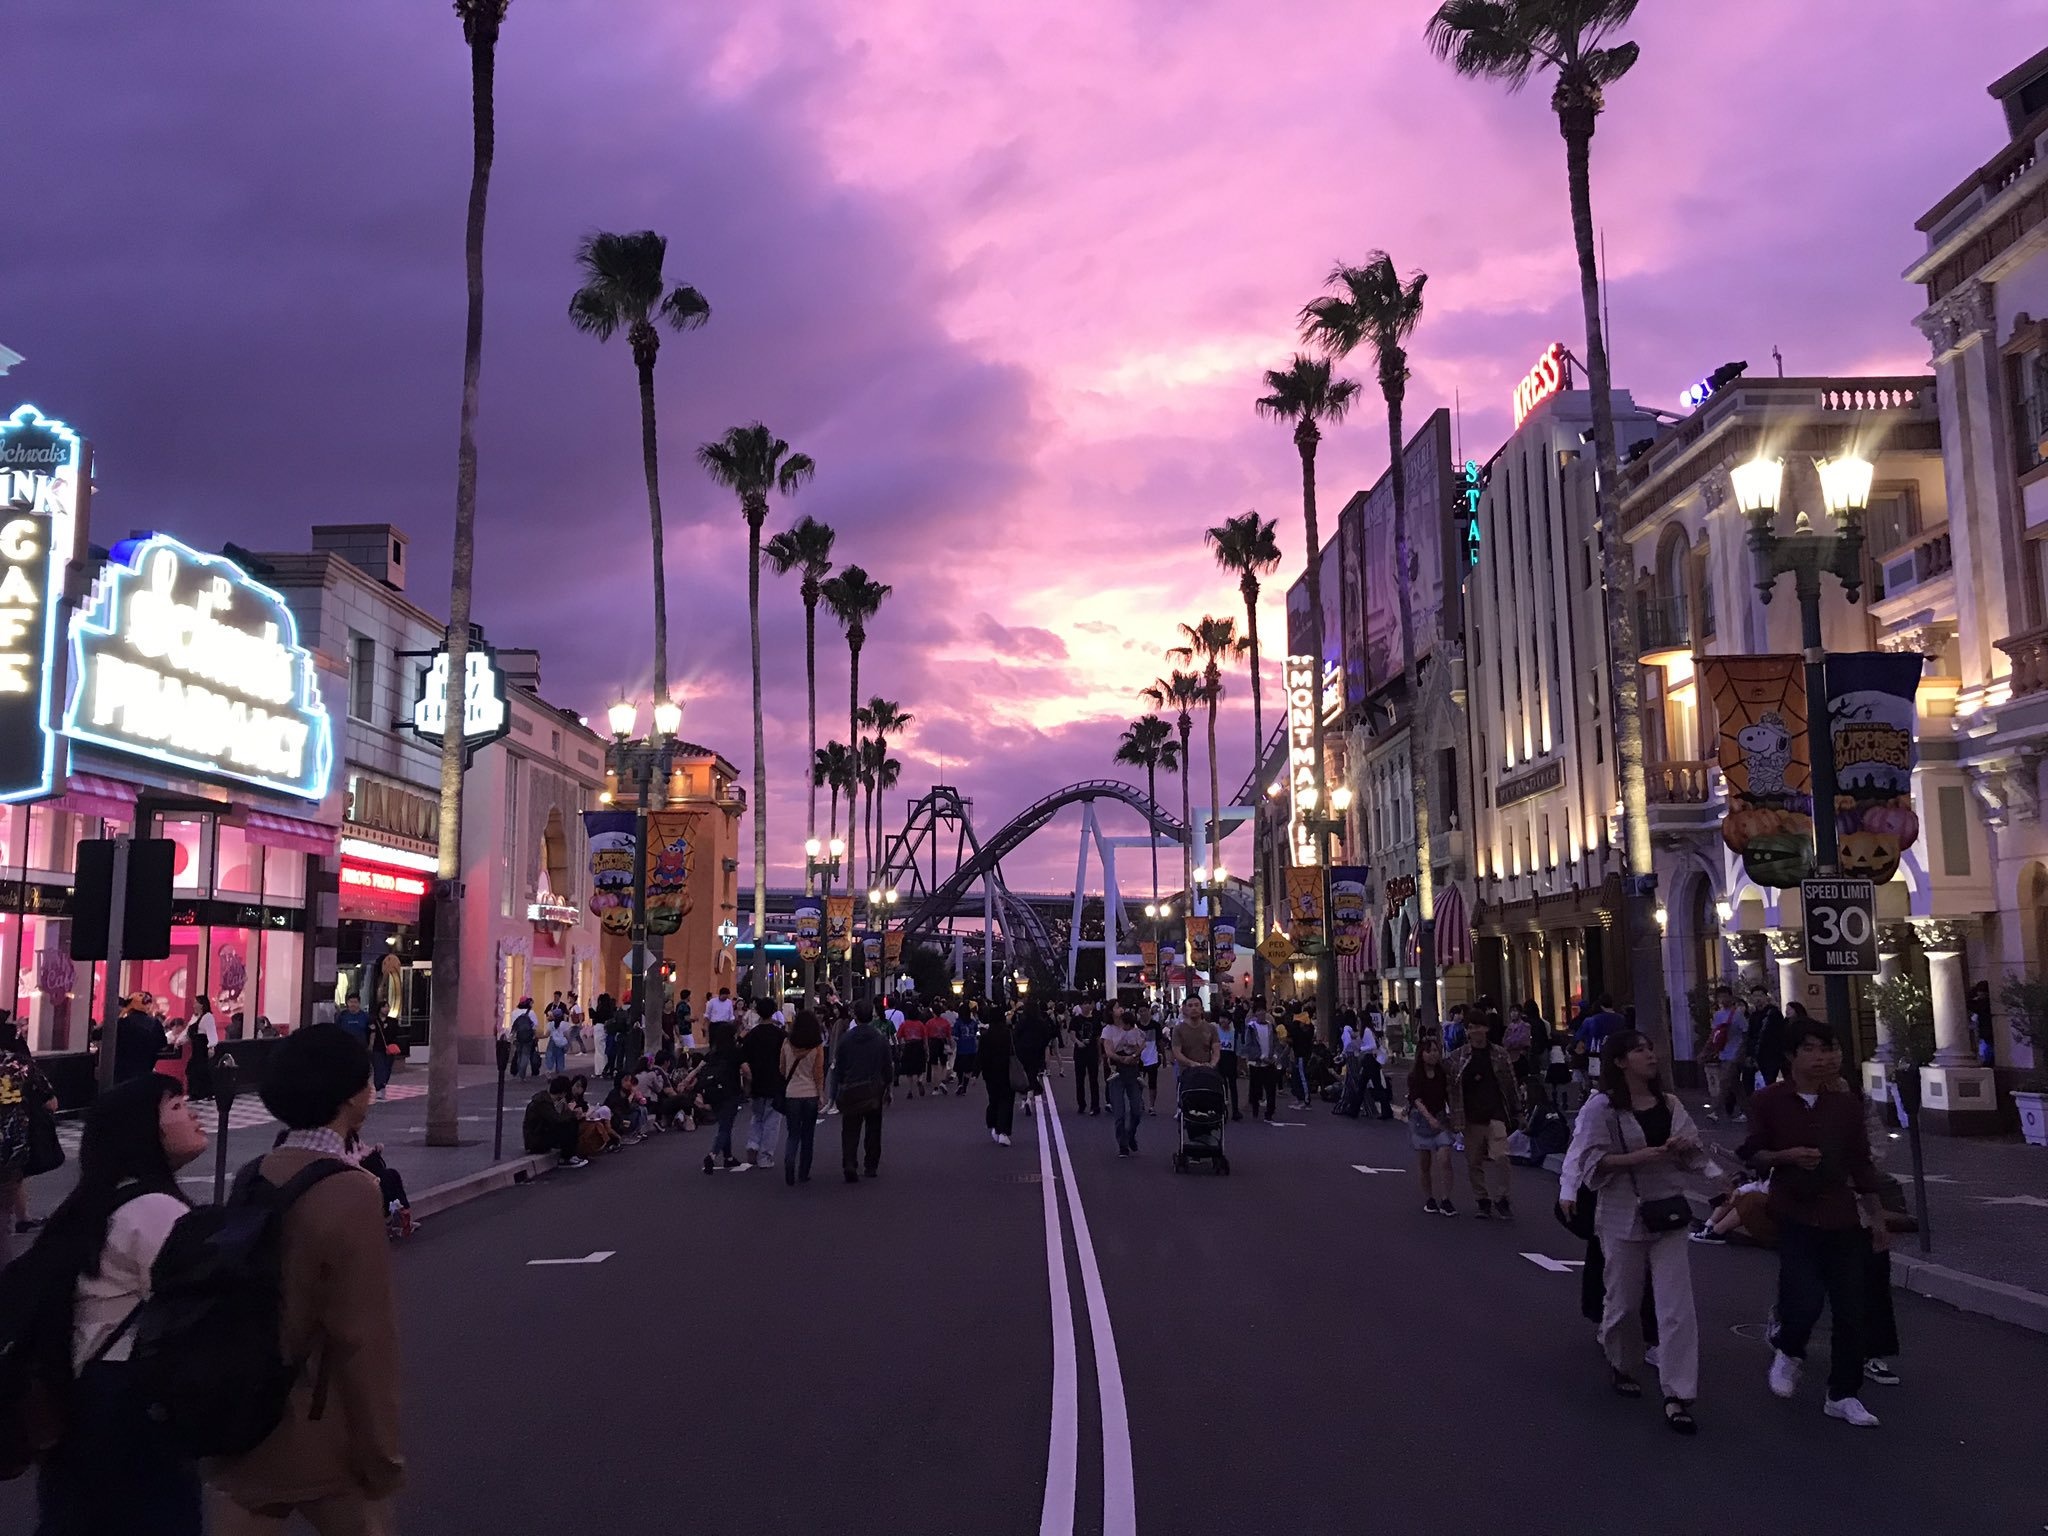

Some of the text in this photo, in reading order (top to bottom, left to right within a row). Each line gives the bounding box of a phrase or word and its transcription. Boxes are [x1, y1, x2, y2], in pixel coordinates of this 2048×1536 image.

[1513, 343, 1560, 430] KRESS
[355, 777, 441, 840] DARKROO
[1805, 885, 1869, 899] SPEED LIMIT
[1812, 906, 1870, 945] 30
[1827, 951, 1859, 965] MILES
